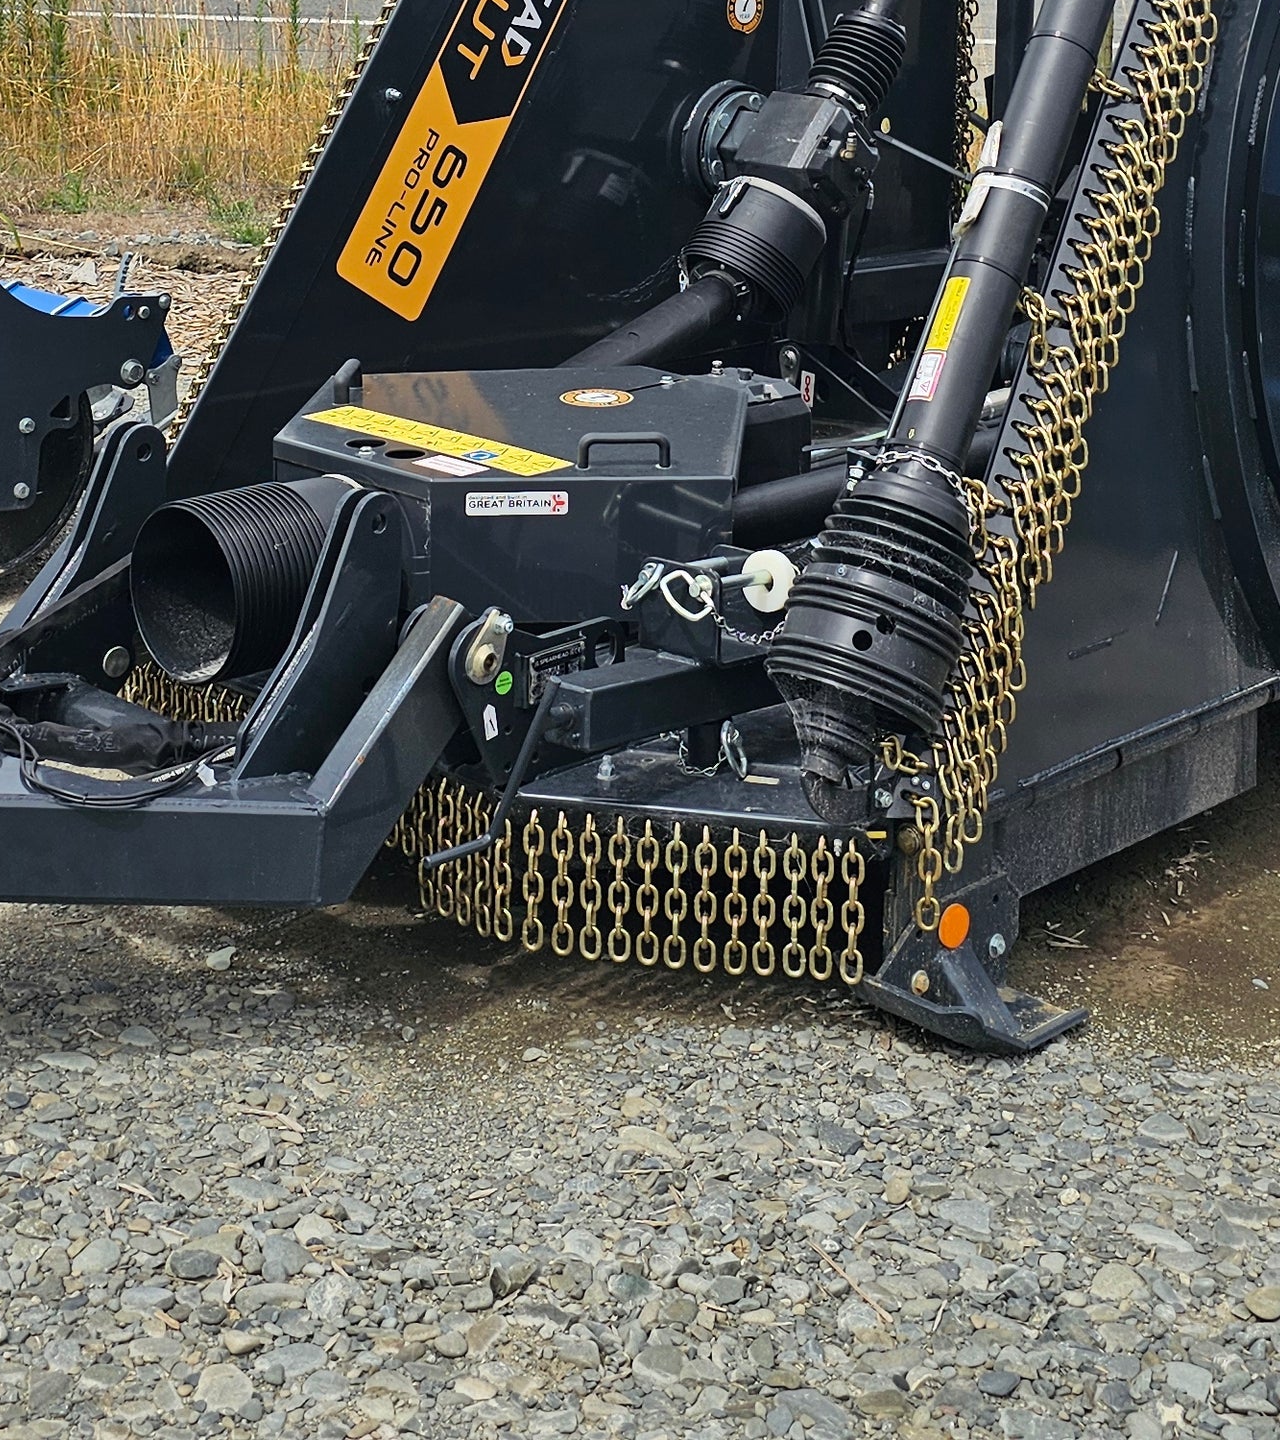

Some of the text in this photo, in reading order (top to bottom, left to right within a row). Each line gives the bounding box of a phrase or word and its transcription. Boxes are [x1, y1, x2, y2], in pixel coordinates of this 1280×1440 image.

[364, 127, 437, 268] PRO-LINE
[387, 142, 469, 288] 650
[468, 499, 551, 509] GREAT BRITAIN
[540, 650, 570, 665] SPEARHEAD
